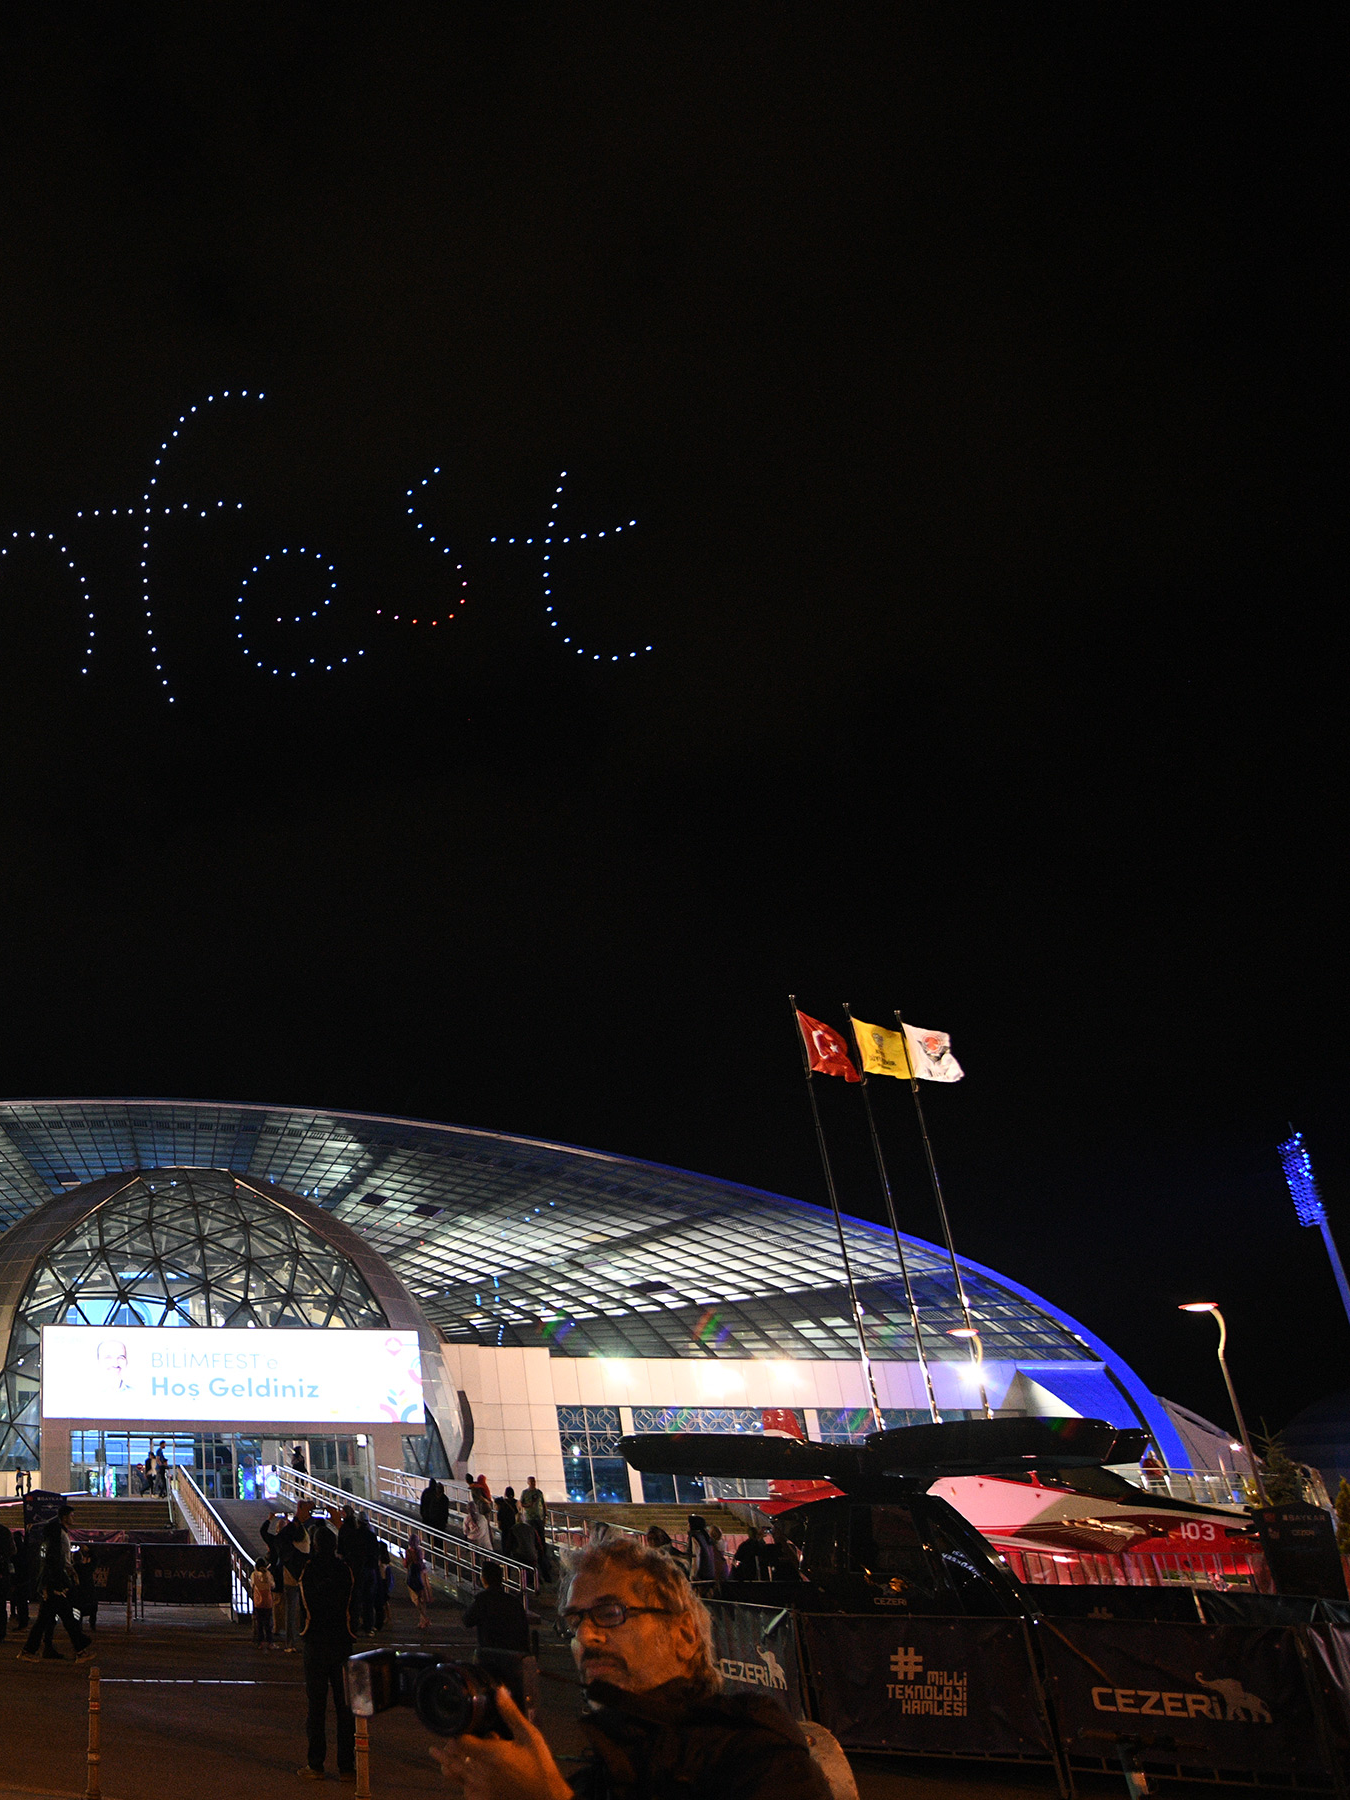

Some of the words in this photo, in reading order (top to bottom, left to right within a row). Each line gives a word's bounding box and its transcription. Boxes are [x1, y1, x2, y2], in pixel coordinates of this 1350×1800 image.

[151, 1376, 201, 1400] Hoş
[208, 1377, 320, 1399] Geldiniz
[1180, 1521, 1216, 1541] 103
[163, 1569, 216, 1579] BAYKAR
